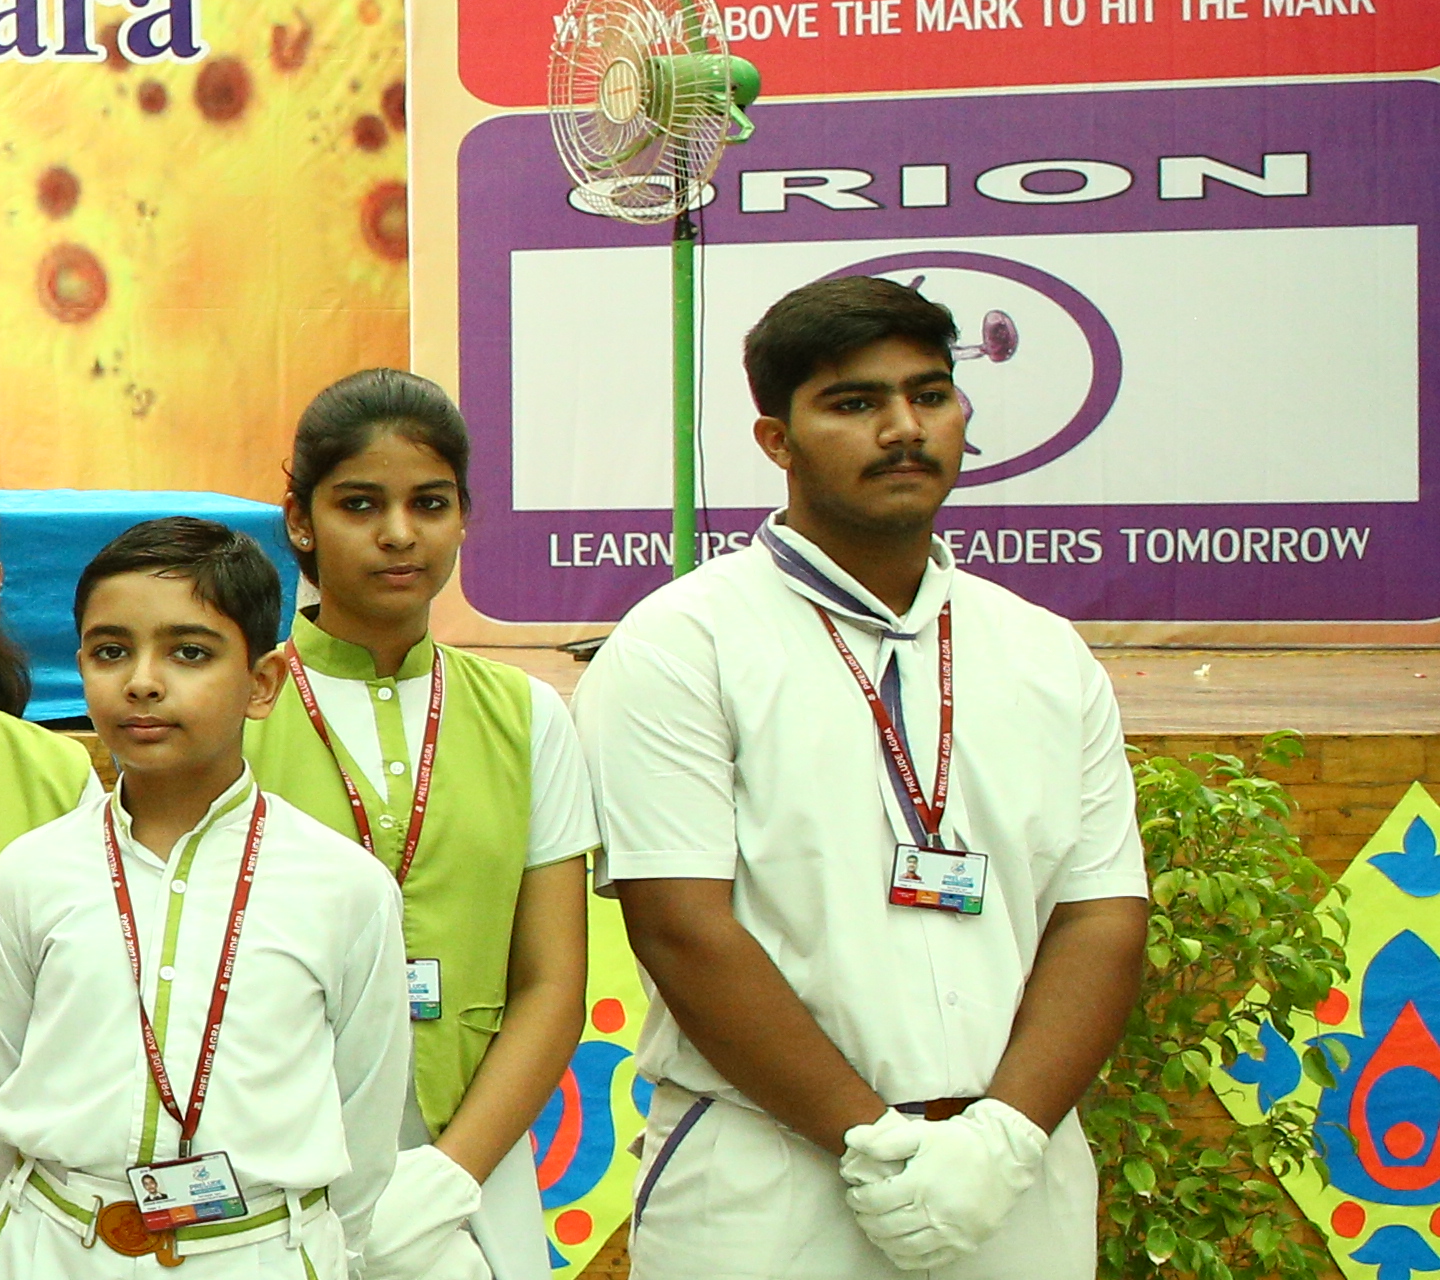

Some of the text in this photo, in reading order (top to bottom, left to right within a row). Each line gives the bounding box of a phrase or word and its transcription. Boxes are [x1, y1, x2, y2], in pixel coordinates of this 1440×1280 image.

[568, 151, 1311, 216] ORION
[945, 527, 1102, 566] EADERS
[1124, 525, 1372, 565] TOMORROW
[418, 743, 433, 804] PRELUDE AGRA
[884, 727, 919, 797] PRELUDE AGRA
[938, 732, 951, 798] PRELUDE AGRA
[222, 909, 244, 981] PRELUDE AGRA
[144, 1024, 170, 1097] PRELUDE AGRA
[196, 1022, 221, 1098] PRELUDE AGRA
